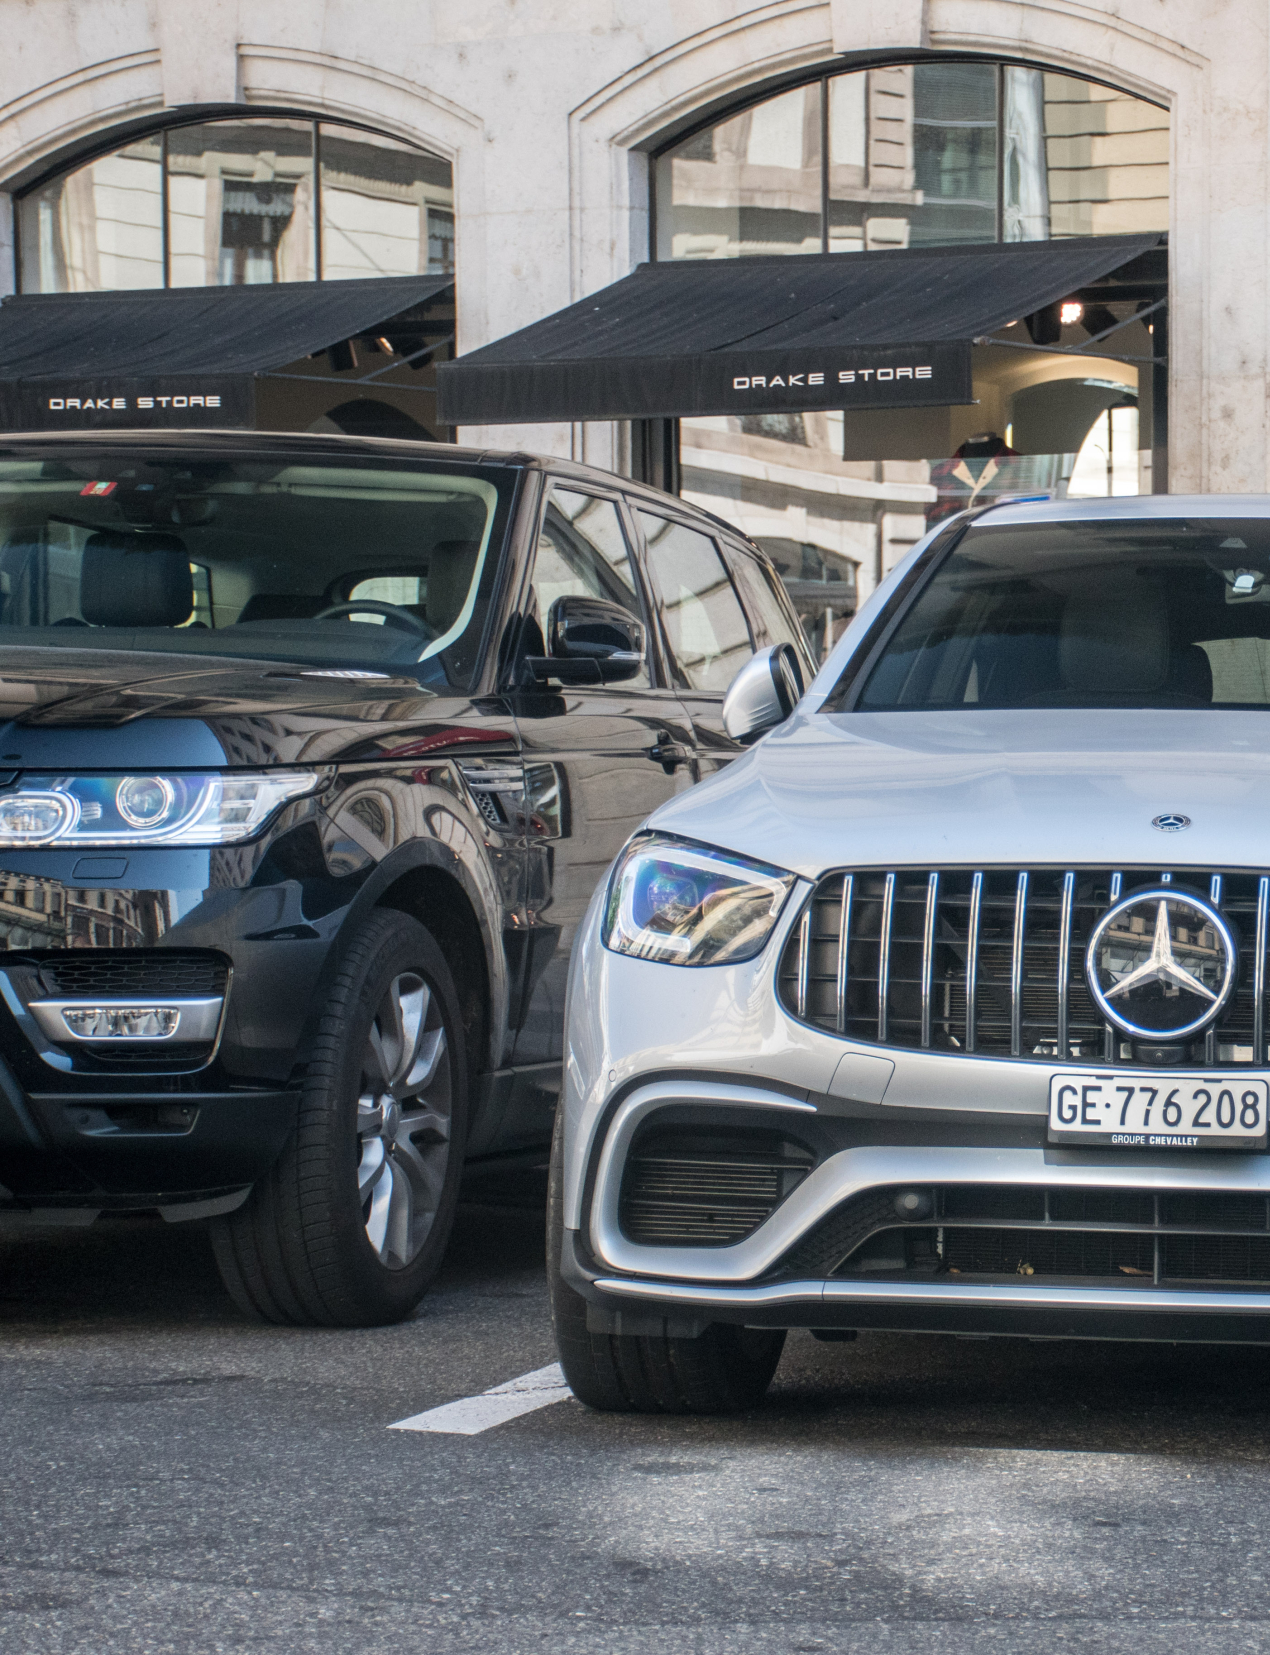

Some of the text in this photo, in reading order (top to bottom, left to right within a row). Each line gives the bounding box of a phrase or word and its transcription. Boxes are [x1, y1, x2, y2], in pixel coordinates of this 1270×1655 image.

[733, 366, 932, 390] DRAKE STORE
[49, 395, 221, 410] DRAKE STORE
[1111, 1134, 1199, 1146] GROUPE CHEVALLEY
